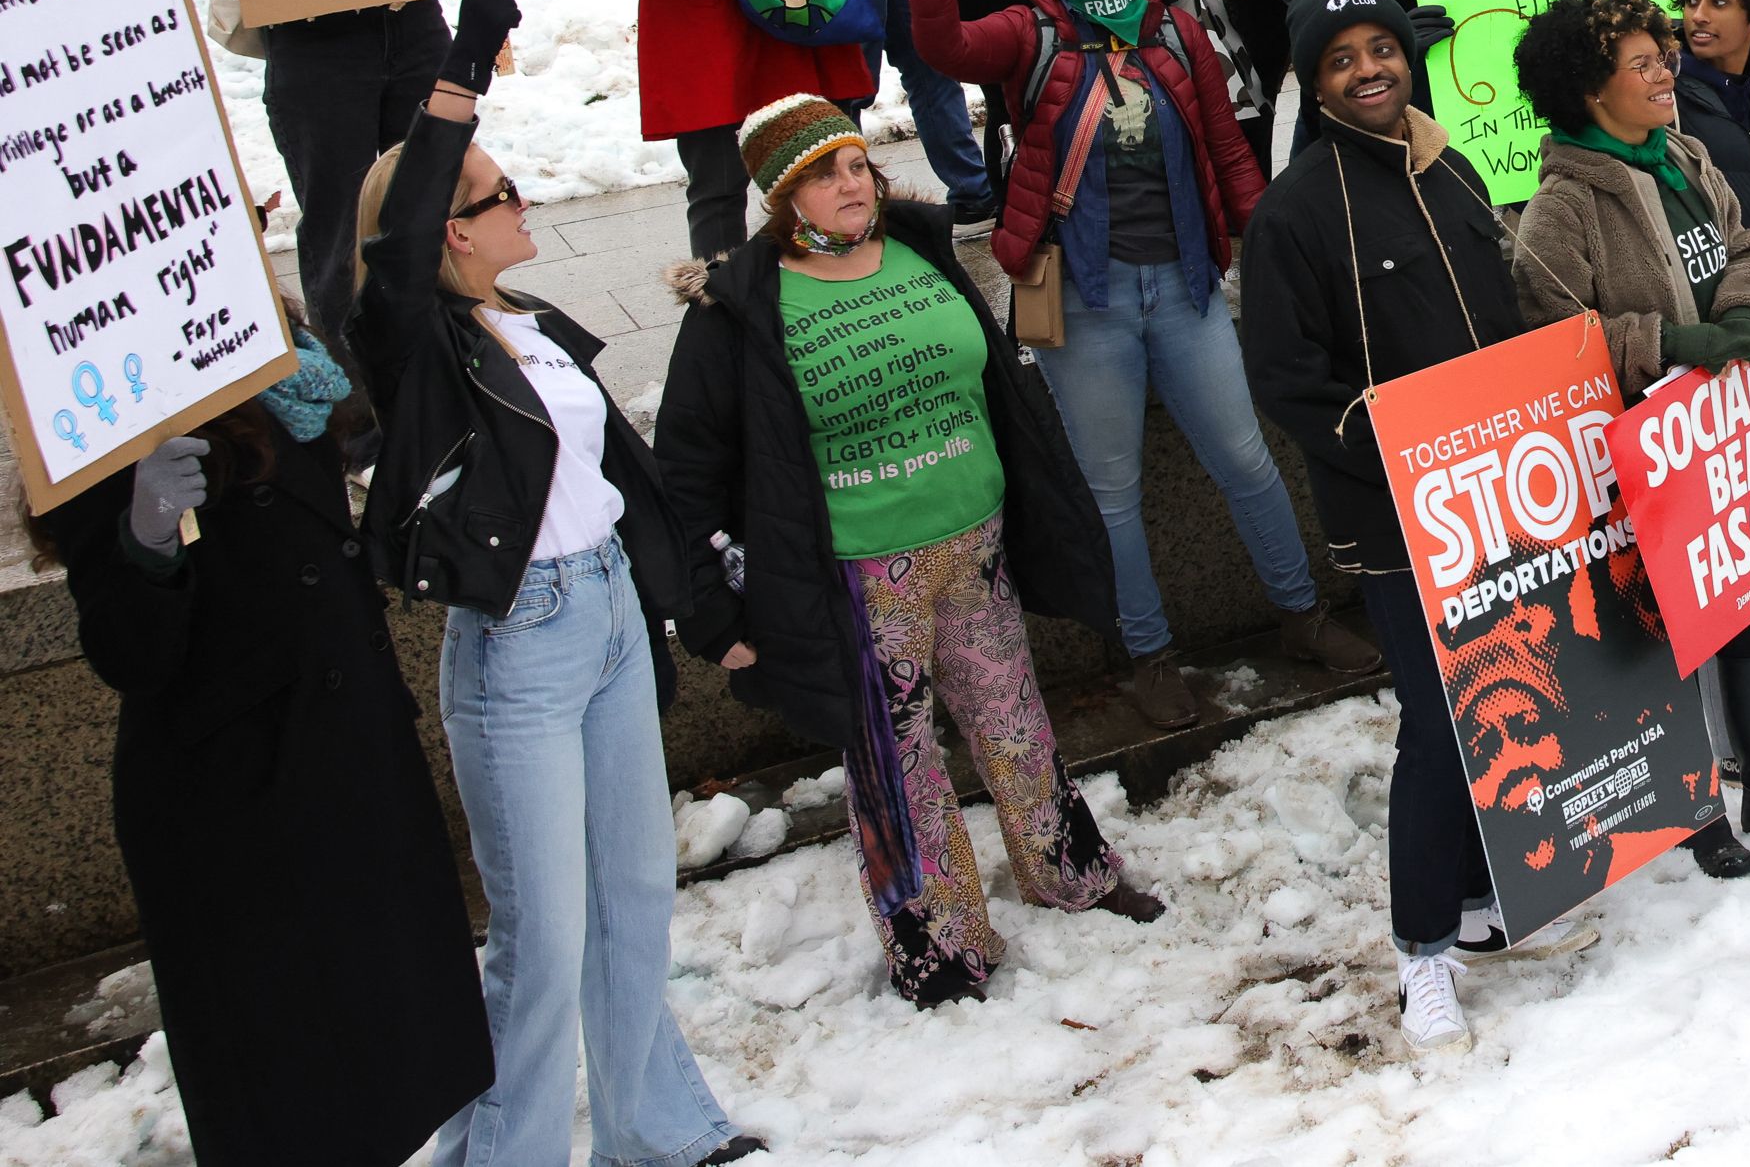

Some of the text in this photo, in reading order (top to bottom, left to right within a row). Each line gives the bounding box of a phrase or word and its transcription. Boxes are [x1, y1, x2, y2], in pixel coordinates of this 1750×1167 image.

[2, 167, 234, 309] FUNDAMENTAL
[803, 332, 905, 387] gun laws.
[811, 342, 954, 407] voting rights.
[826, 408, 979, 464] LGBTQ+ rights.
[1399, 373, 1613, 475] TOGETHER WE CAN
[1413, 409, 1619, 591] STOP
[1440, 518, 1636, 629] DEPORTATIONS
[1546, 723, 1665, 799] Communist Party USA
[1570, 790, 1657, 850] YOUNG COMMUNIST LEAGUE
